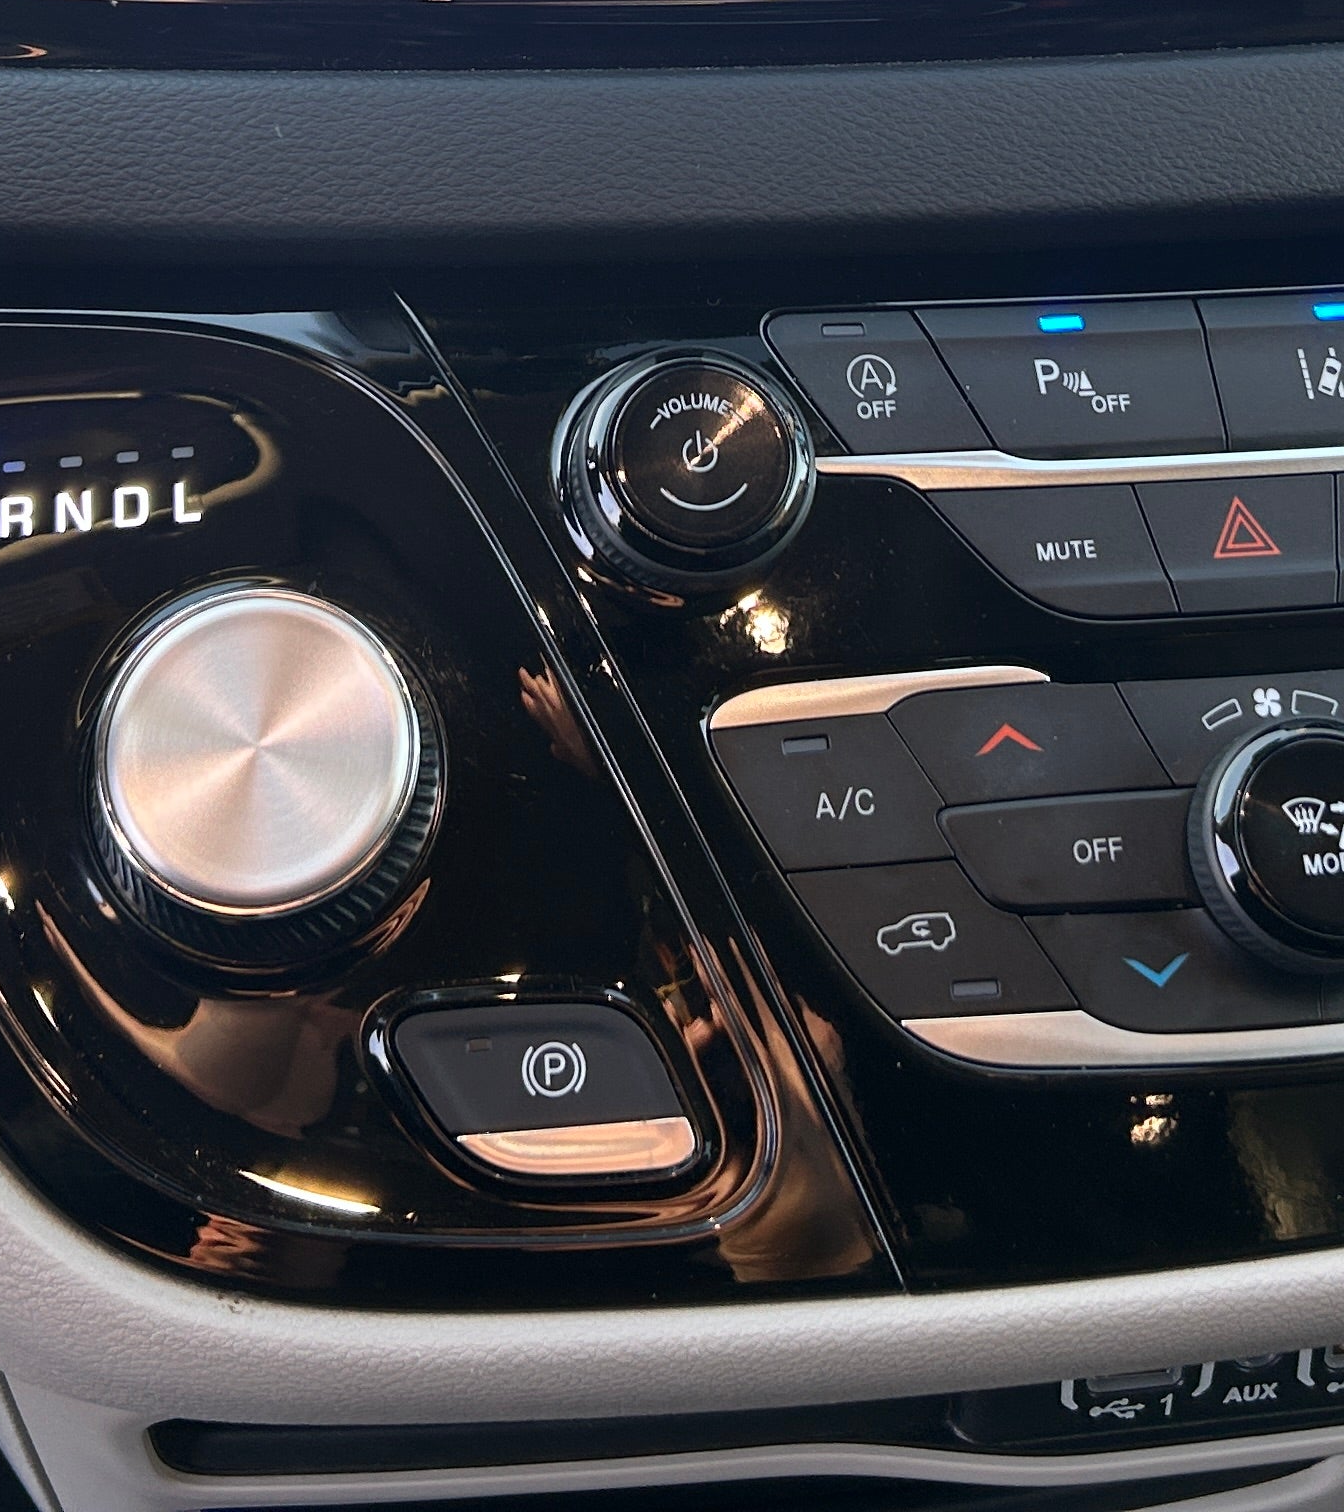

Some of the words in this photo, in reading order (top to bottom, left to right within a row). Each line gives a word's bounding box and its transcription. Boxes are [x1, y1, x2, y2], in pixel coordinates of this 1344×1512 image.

[657, 392, 734, 419] VOLUME
[856, 398, 897, 421] OFF
[1091, 392, 1131, 414] OFF
[1036, 539, 1098, 563] MUTE
[815, 786, 875, 822] A/C
[1073, 836, 1124, 865] OFF
[1160, 1393, 1174, 1417] 1
[1223, 1381, 1278, 1405] AUX
